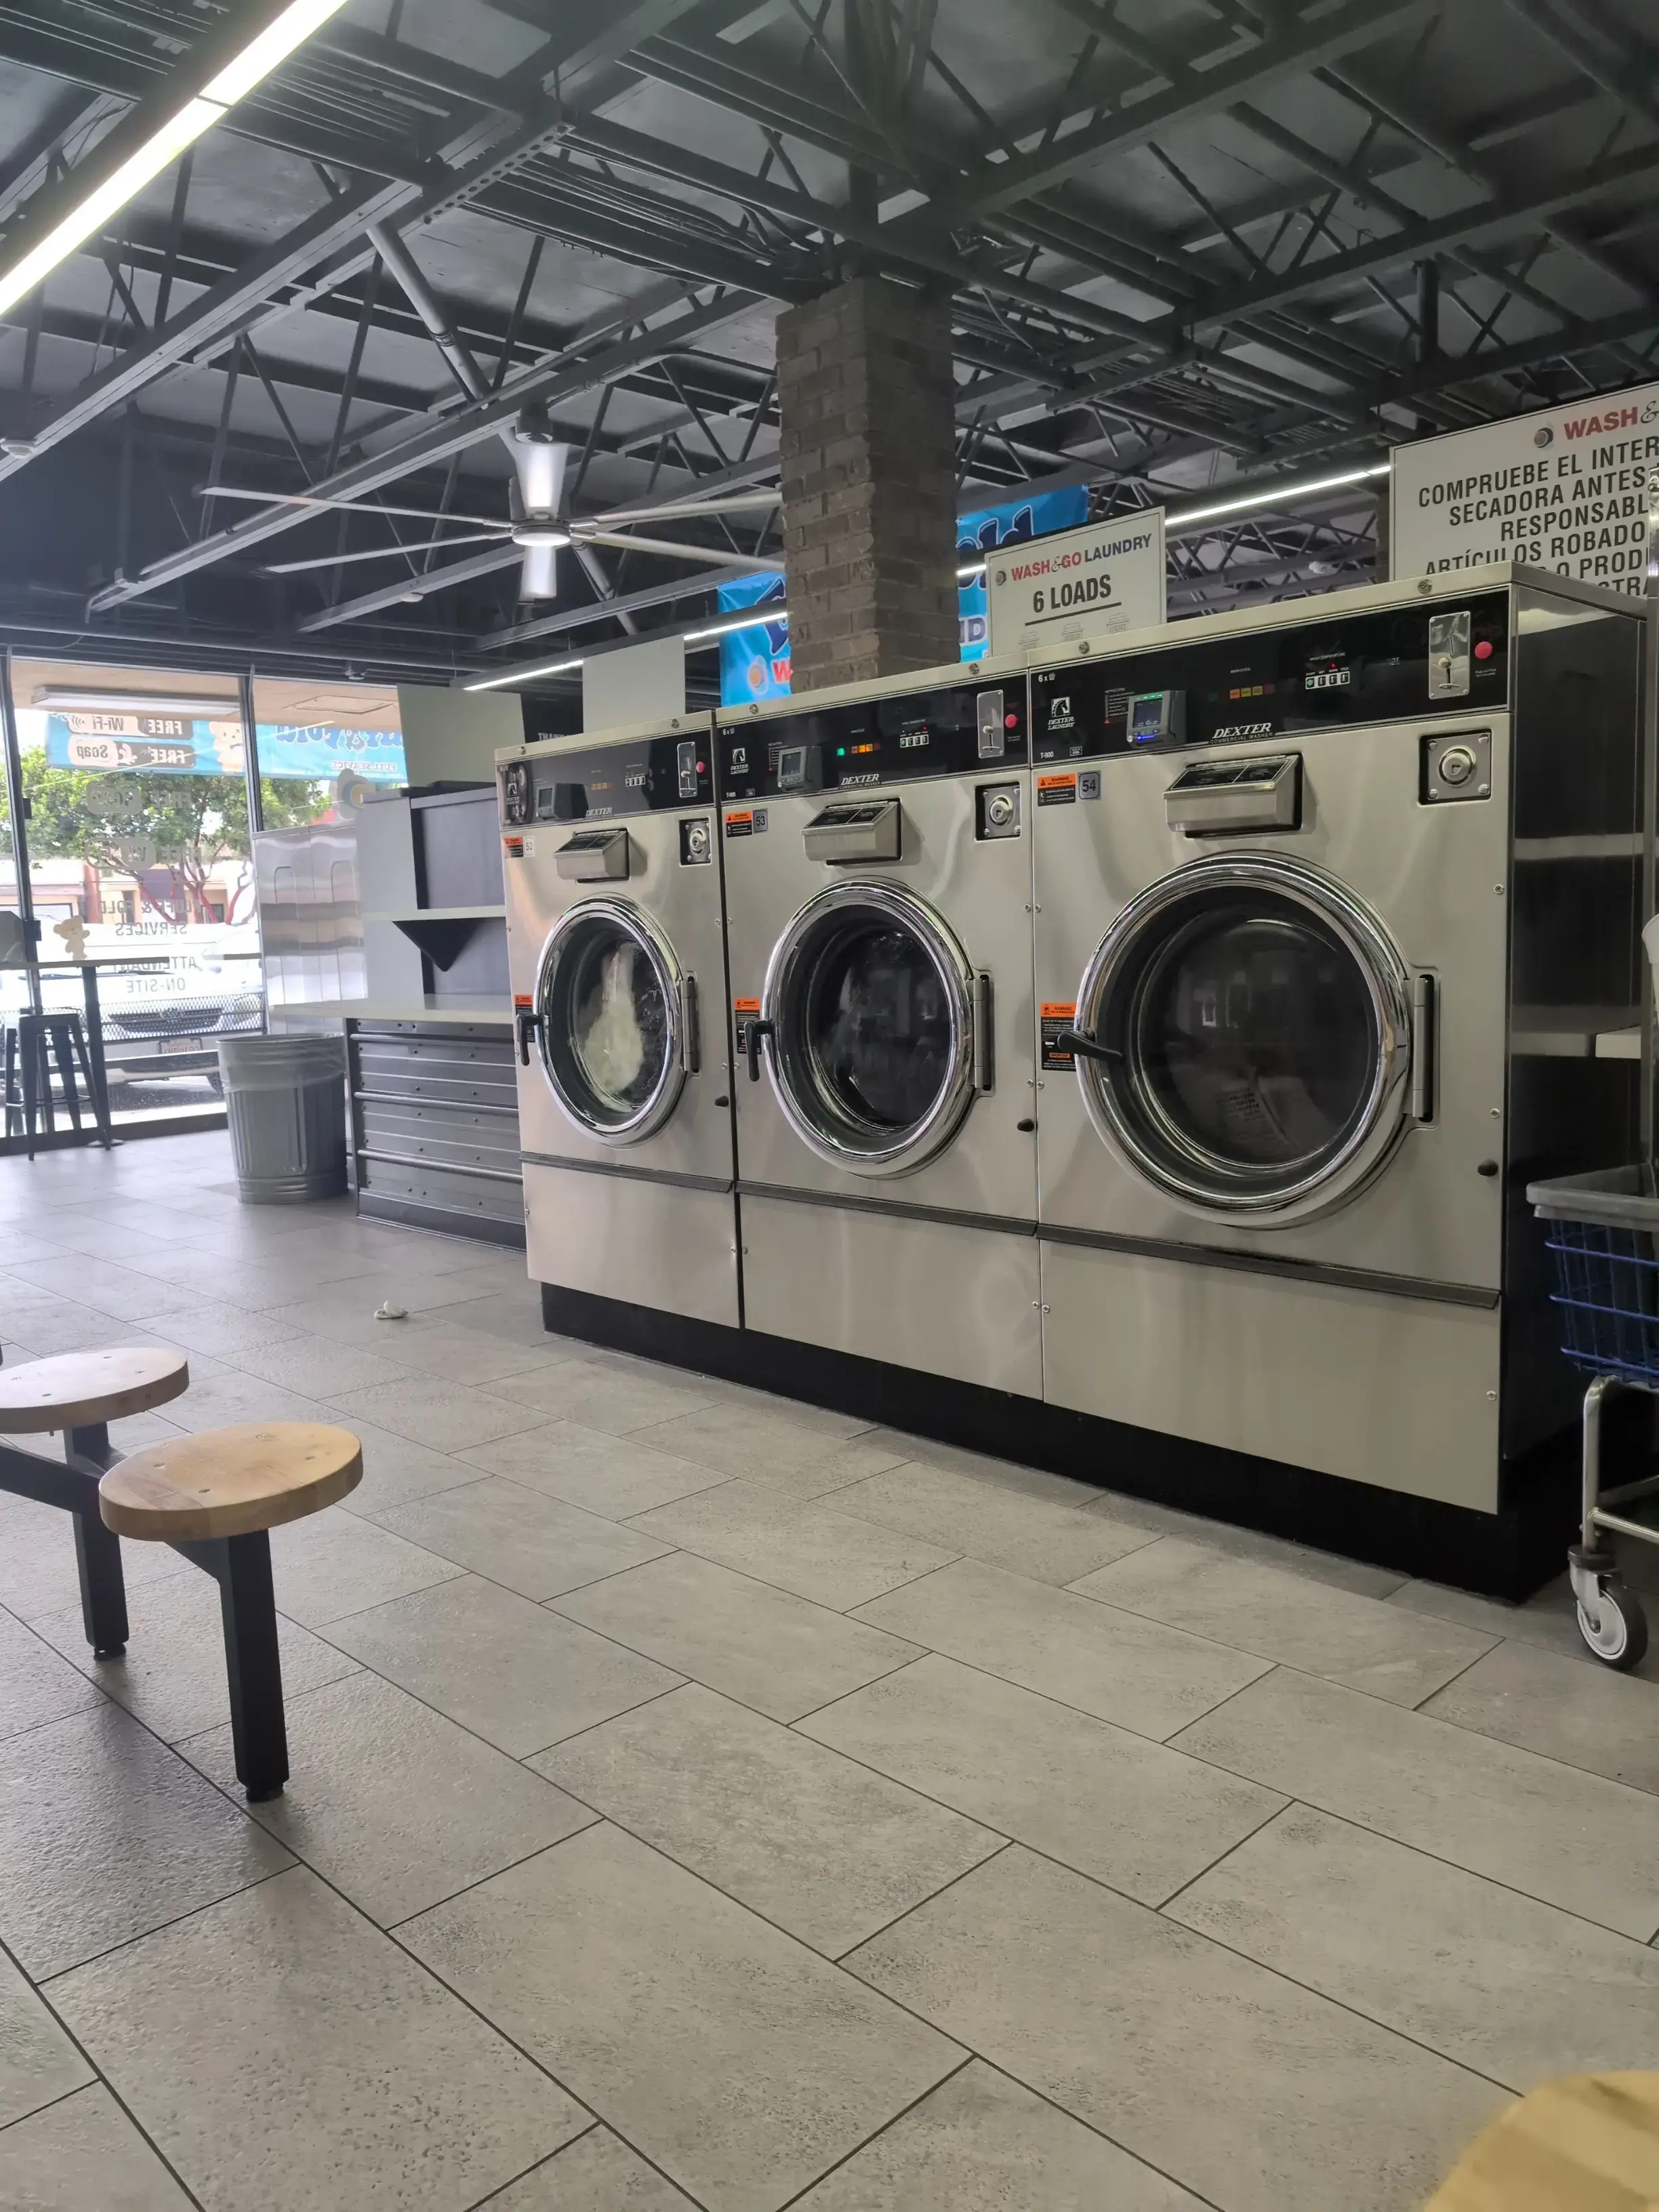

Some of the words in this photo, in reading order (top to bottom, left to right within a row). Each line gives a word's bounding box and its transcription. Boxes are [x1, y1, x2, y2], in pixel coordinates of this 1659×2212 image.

[1418, 460, 1549, 508] COMPRUEBE
[1558, 454, 1582, 477] EL
[1449, 483, 1563, 526] SECADORA
[1572, 466, 1646, 501] ANTES
[1501, 493, 1648, 541] RESPONSABL
[1551, 520, 1645, 558] ROBADO
[1084, 533, 1152, 563] LAUNDRY
[1580, 546, 1648, 579] PROD
[1033, 590, 1044, 613] 6
[1050, 574, 1111, 610] LOADS
[1038, 674, 1043, 682] 6
[1047, 722, 1075, 731] LAUNDRY
[1048, 716, 1075, 726] DEXTER
[1212, 722, 1272, 739] DEXTER
[1210, 735, 1247, 744] COMMERCIAL
[841, 773, 880, 785] DEXTER
[1082, 779, 1097, 792] 54
[585, 806, 613, 817] DEXTER
[756, 815, 766, 827] 53
[525, 842, 533, 851] 52
